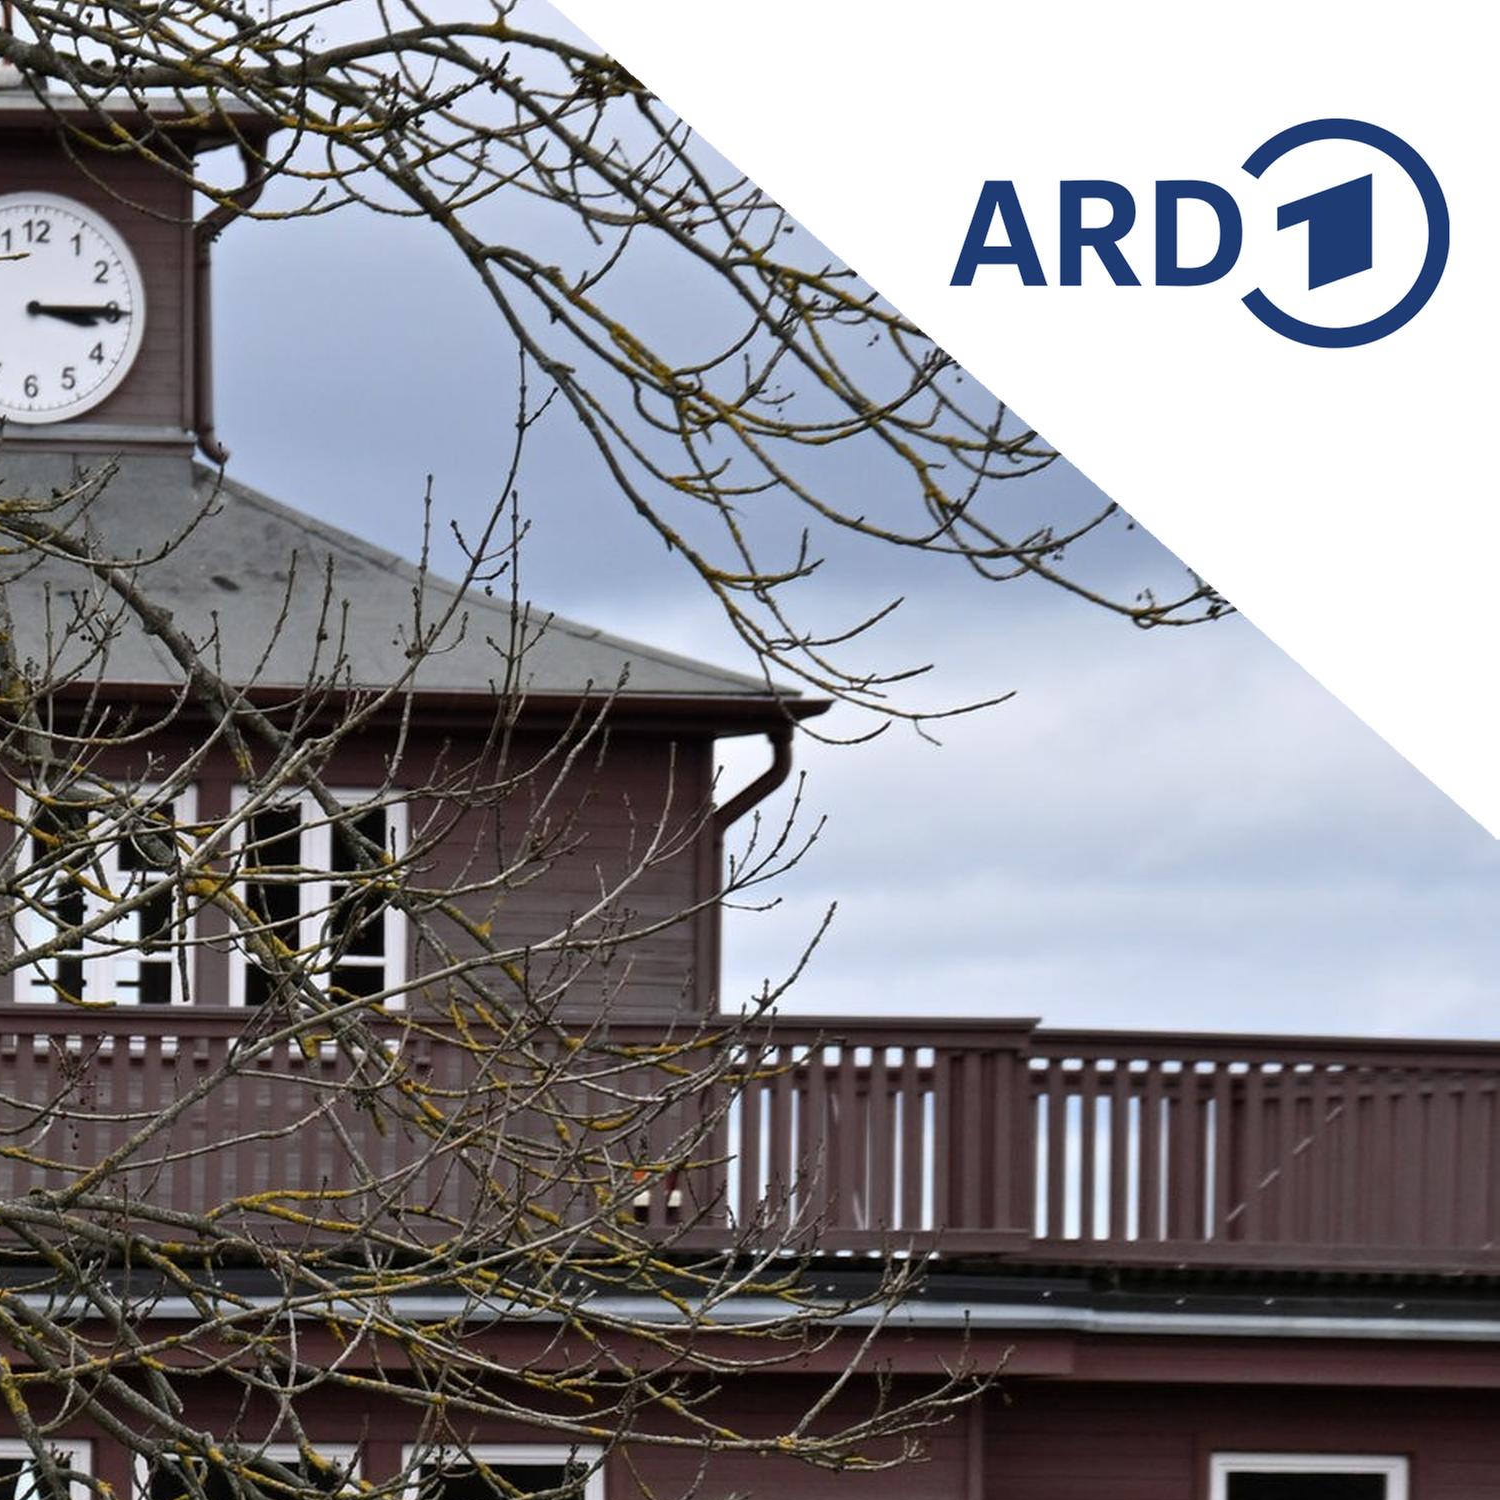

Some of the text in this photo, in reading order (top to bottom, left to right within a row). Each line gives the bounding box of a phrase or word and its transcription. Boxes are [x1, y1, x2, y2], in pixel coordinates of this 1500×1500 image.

[22, 219, 51, 244] 12
[71, 233, 82, 256] 1
[94, 260, 109, 284] 2
[88, 342, 104, 365] 4
[23, 375, 38, 398] 6
[61, 367, 76, 390] 5
